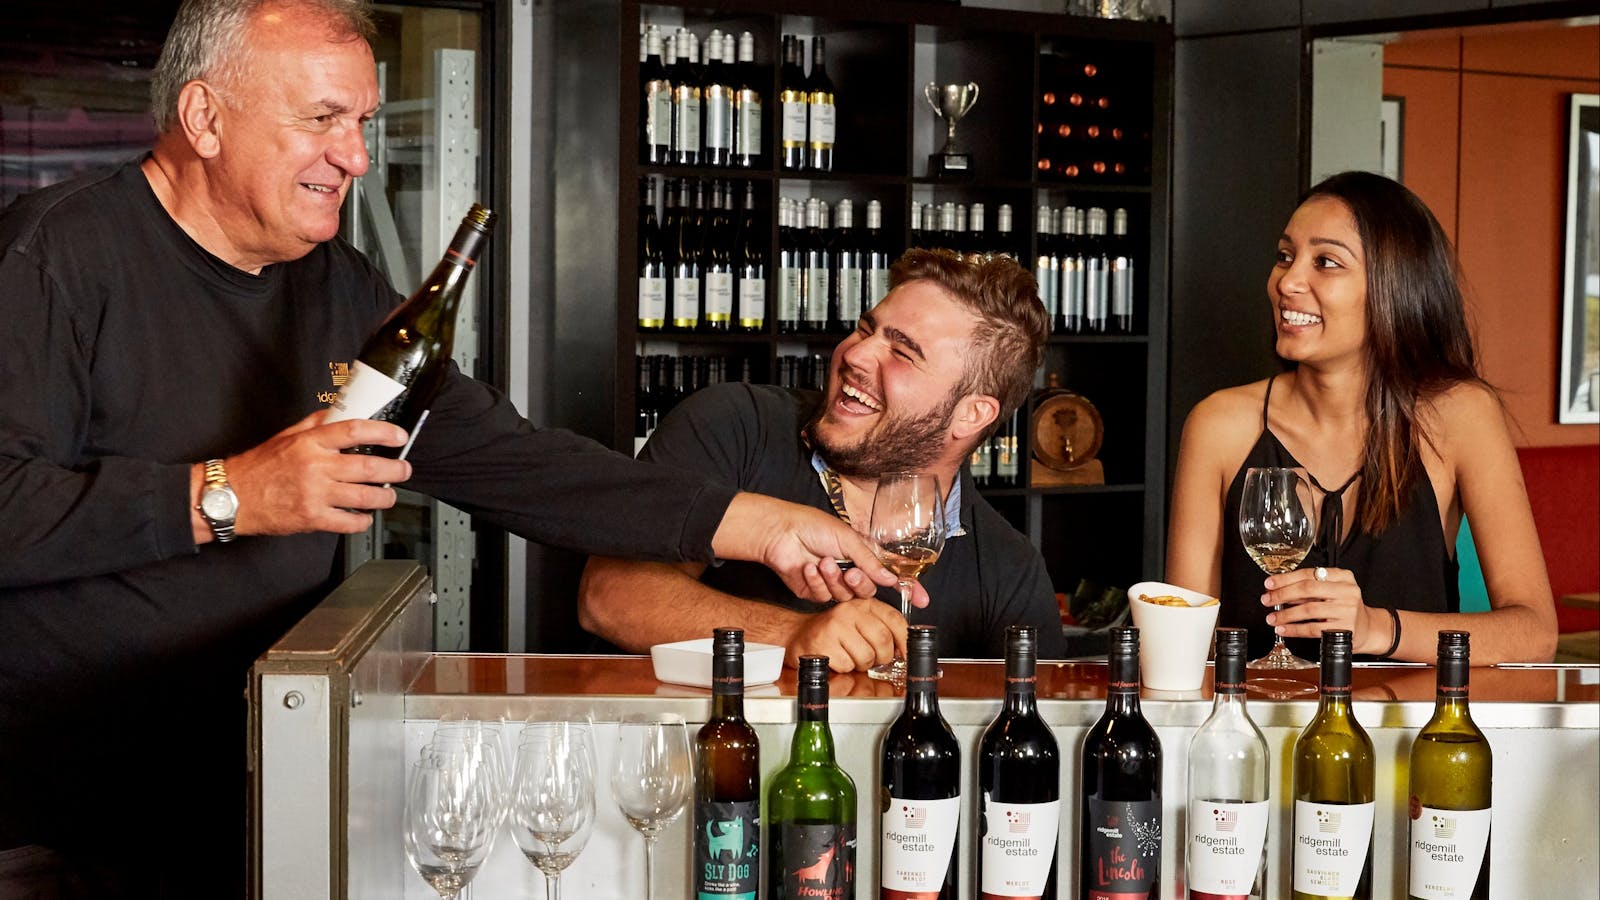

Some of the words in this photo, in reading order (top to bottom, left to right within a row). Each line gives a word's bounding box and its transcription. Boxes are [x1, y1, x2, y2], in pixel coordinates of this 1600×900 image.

[886, 832, 927, 844] ridgemill
[988, 836, 1031, 848] ridgemill
[1195, 833, 1237, 846] ridgemill
[1299, 835, 1341, 848] ridgemill
[902, 843, 935, 852] estate
[1005, 848, 1038, 857] estate
[1212, 845, 1245, 855] estate
[1315, 847, 1349, 857] estate
[1415, 840, 1456, 853] ridgemill
[1110, 846, 1127, 864] the
[1431, 853, 1465, 863] estate
[704, 862, 725, 880] SLY
[728, 863, 750, 881] DOG
[1098, 856, 1145, 886] Lincoln
